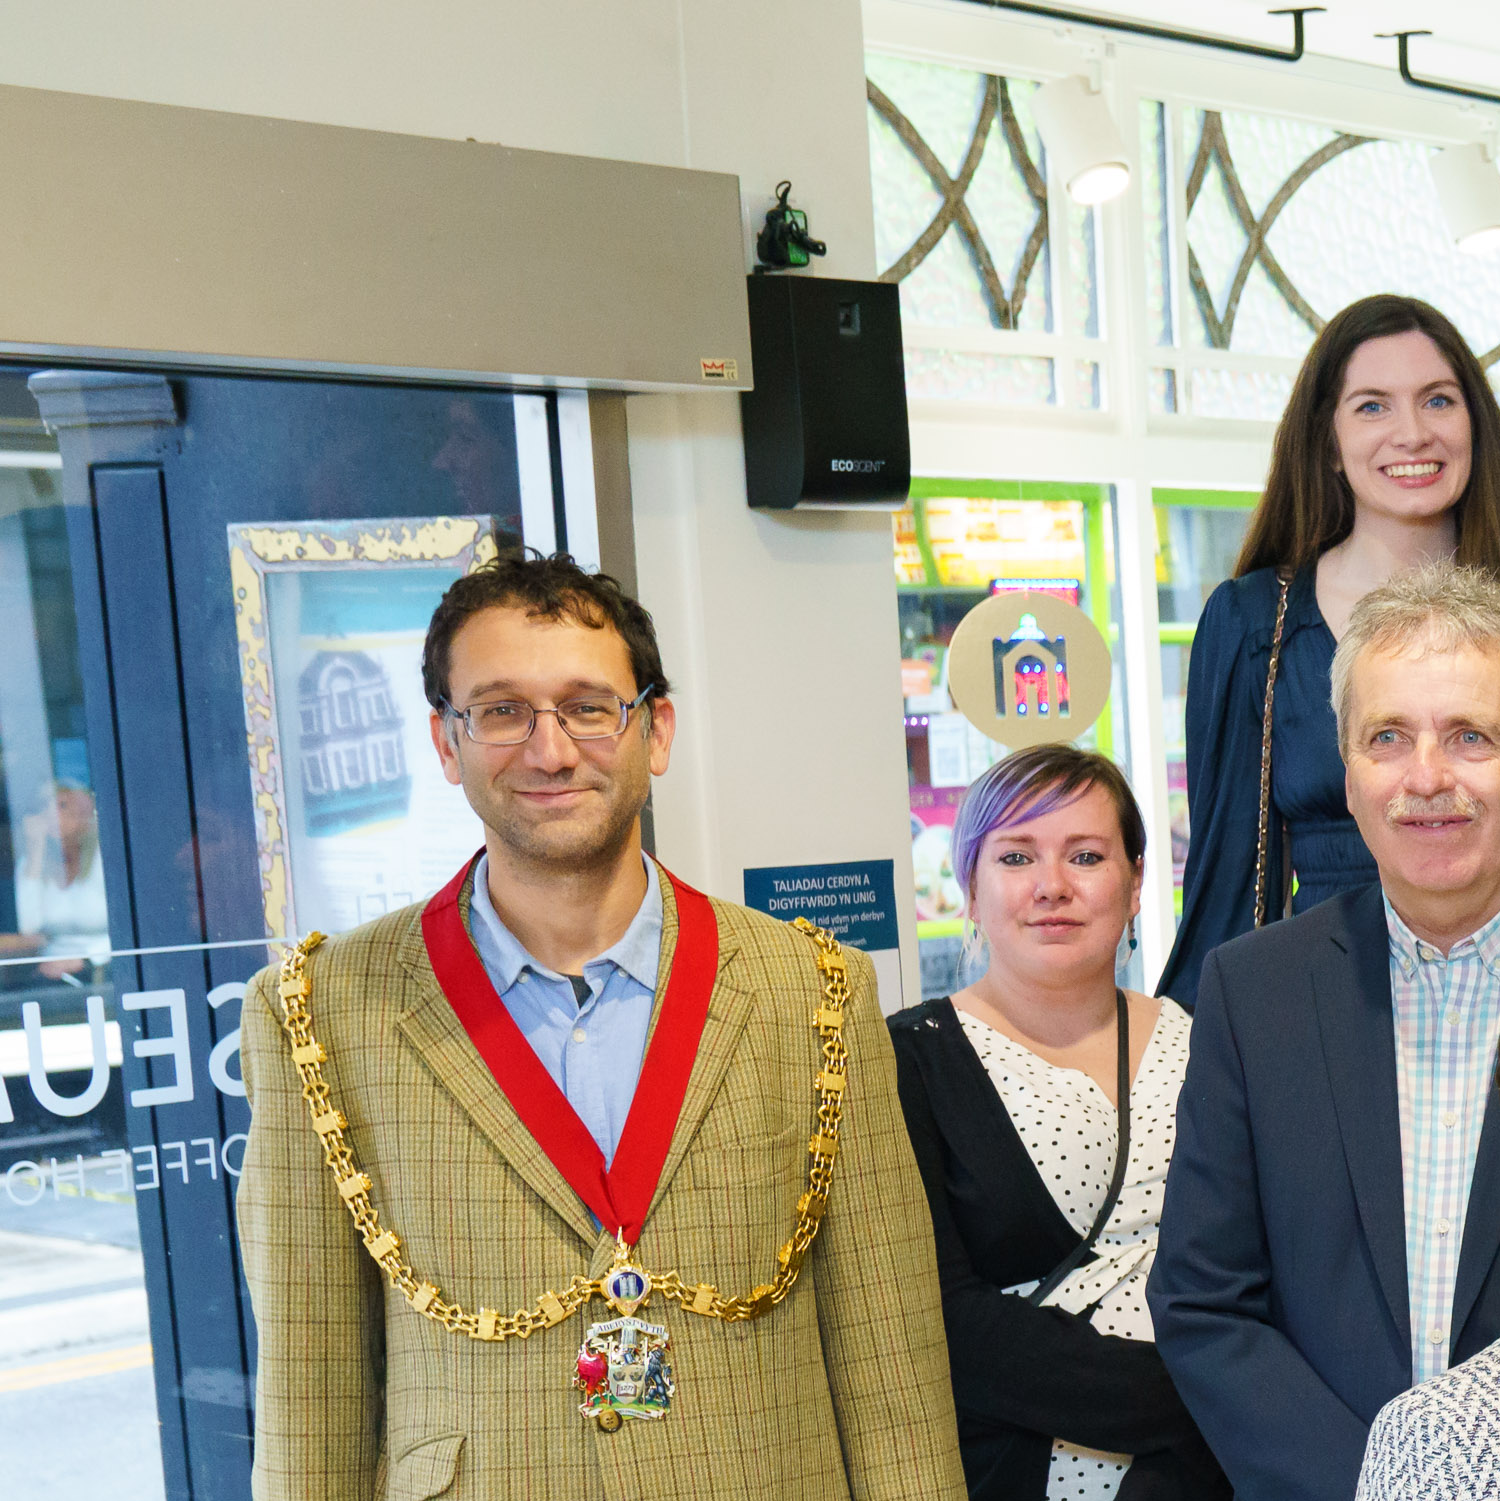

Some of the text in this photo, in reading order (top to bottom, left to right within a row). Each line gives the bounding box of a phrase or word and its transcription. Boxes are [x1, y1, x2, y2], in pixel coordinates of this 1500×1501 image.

[773, 873, 871, 893] TALIADAU CERDYN A
[768, 890, 876, 911] DIGYFFWRDD YN UNIG
[850, 913, 860, 924] yn
[860, 910, 885, 921] derbyn
